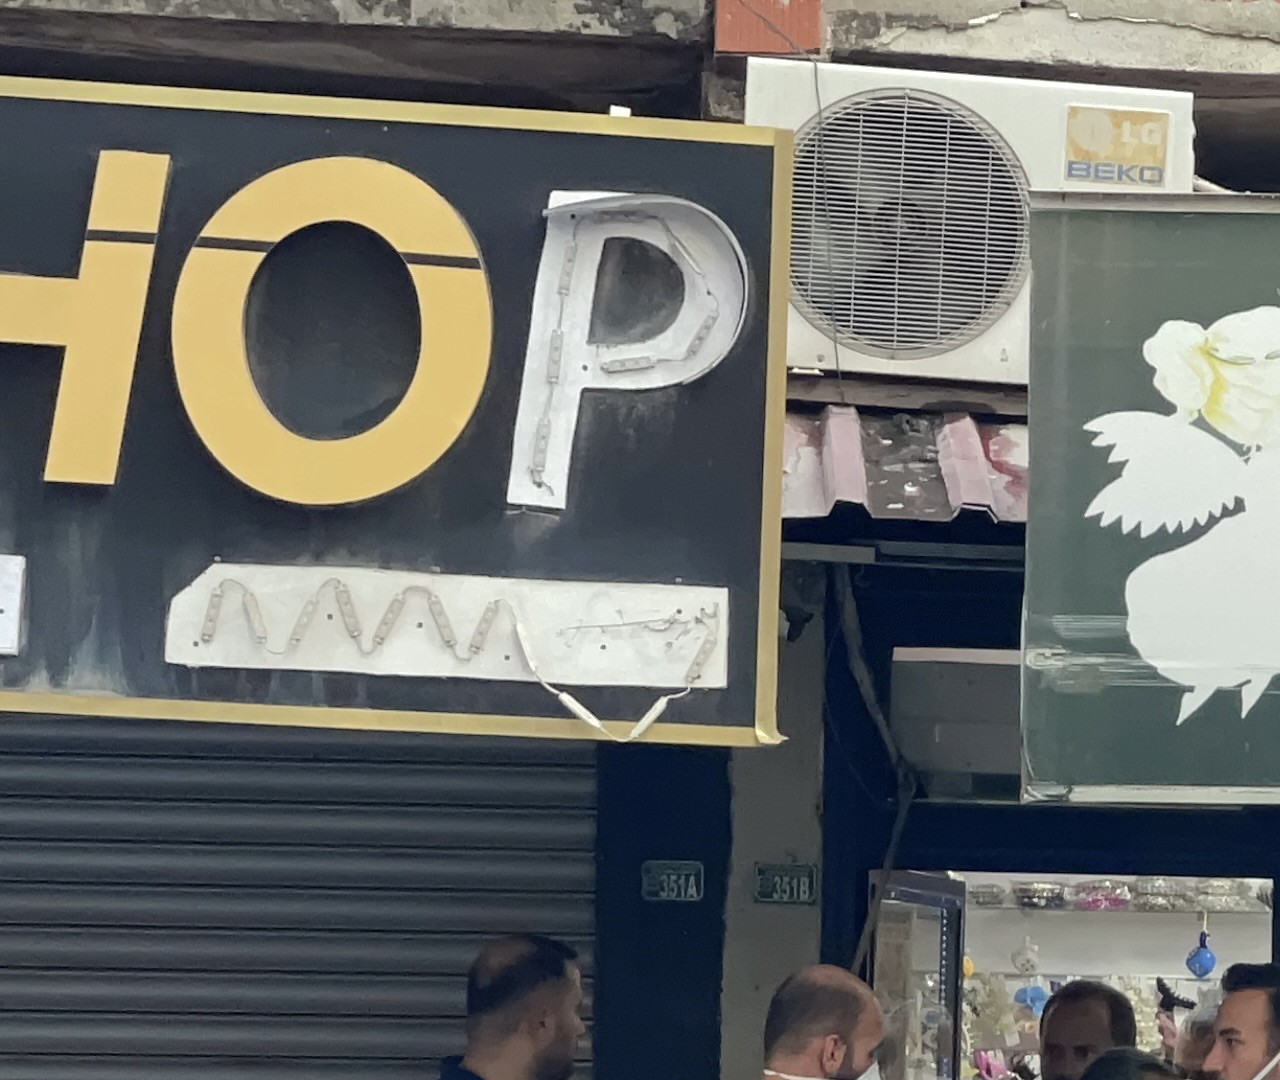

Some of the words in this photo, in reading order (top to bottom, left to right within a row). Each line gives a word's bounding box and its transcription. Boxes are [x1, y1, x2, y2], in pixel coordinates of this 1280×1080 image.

[1067, 159, 1163, 184] BEKO
[658, 873, 699, 899] 351A
[772, 875, 810, 901] 351B
